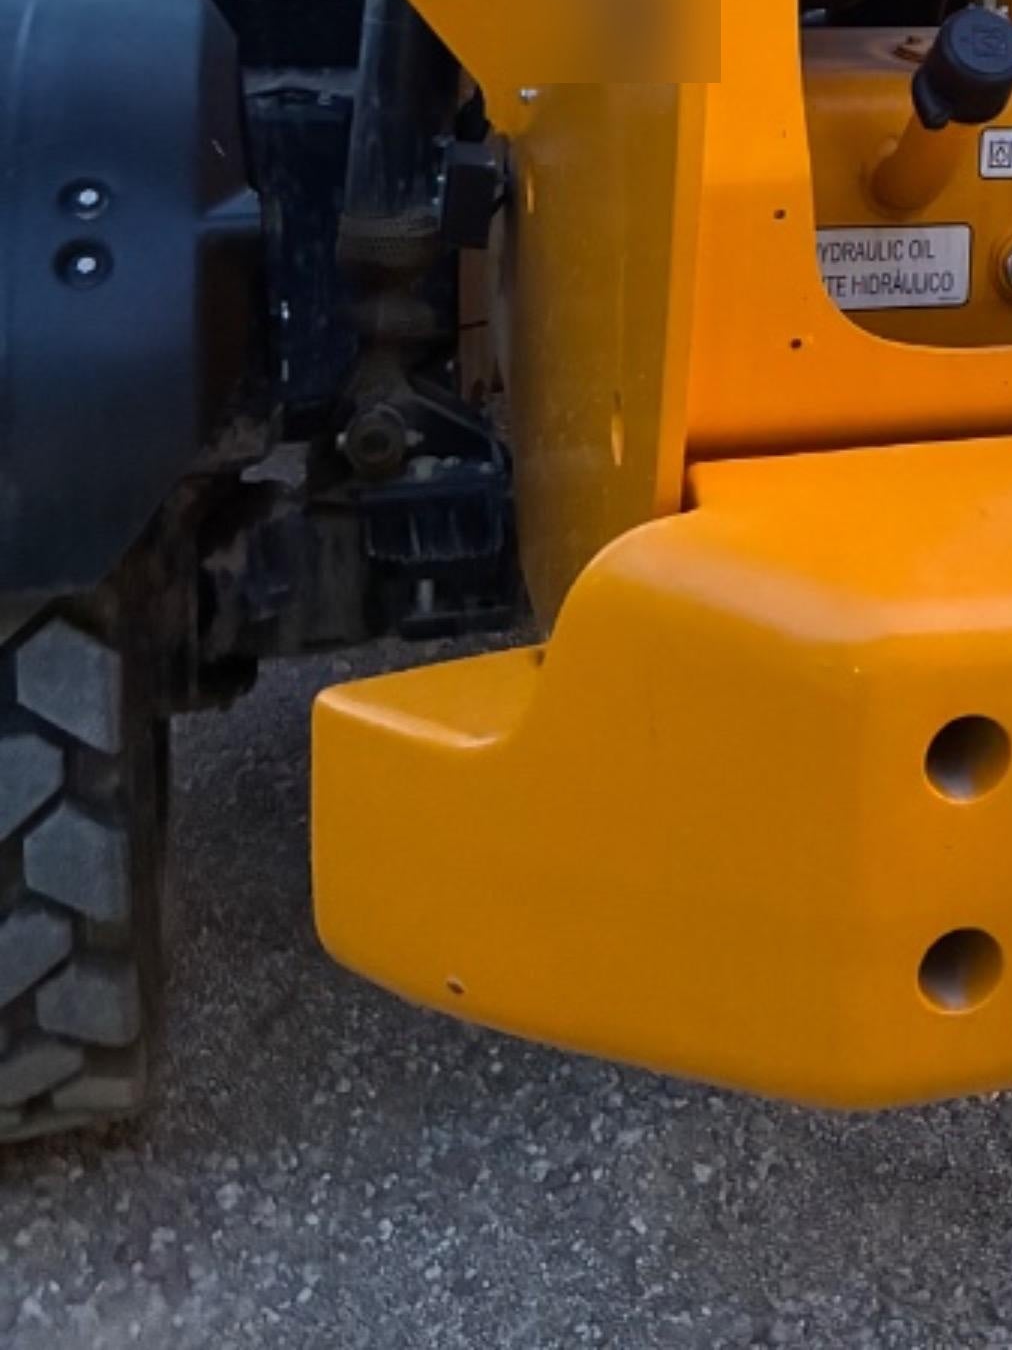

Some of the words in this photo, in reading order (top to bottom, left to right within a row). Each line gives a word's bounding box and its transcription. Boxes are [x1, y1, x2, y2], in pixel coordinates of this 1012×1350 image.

[816, 240, 904, 263] YDRAULIC
[908, 239, 936, 260] OIL
[823, 274, 847, 298] TE
